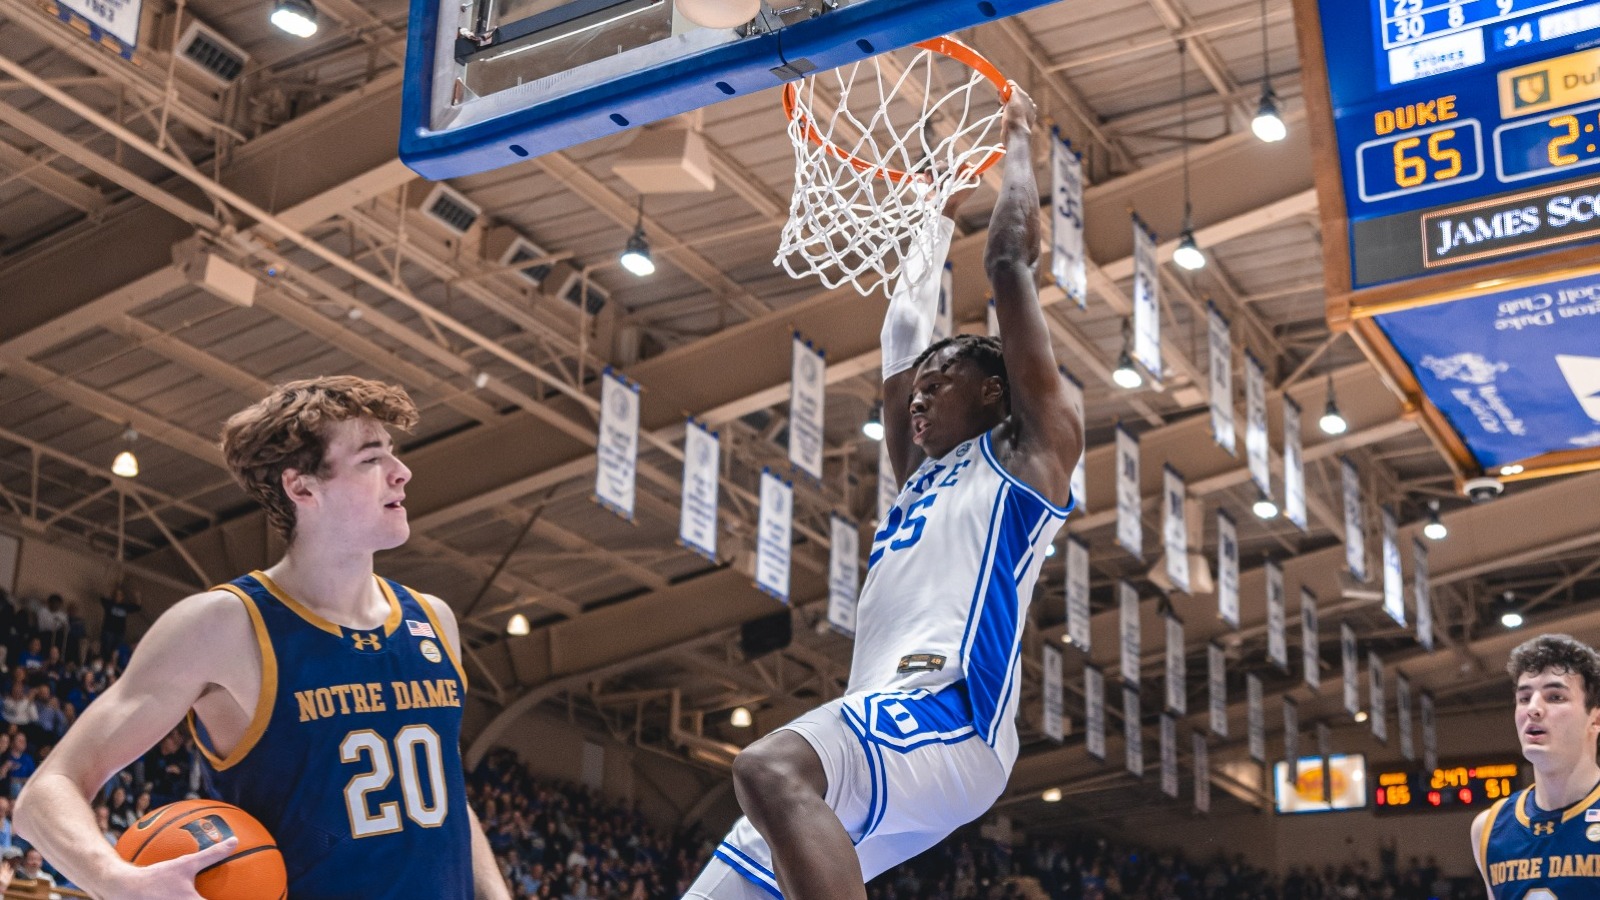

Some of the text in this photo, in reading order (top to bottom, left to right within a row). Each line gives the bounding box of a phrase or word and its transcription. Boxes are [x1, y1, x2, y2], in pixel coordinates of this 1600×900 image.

[1394, 15, 1426, 42] 30
[1504, 22, 1534, 47] 34
[1563, 66, 1600, 91] Du
[1375, 95, 1458, 136] DUKE
[1393, 129, 1462, 188] 65
[1548, 112, 1600, 167] 2:
[1436, 205, 1542, 256] JAMES
[1495, 310, 1555, 331] Duke
[868, 492, 938, 571] 25
[294, 679, 461, 723] NOTRE DAME
[338, 723, 449, 840] 20
[1489, 857, 1543, 887] NOTRE
